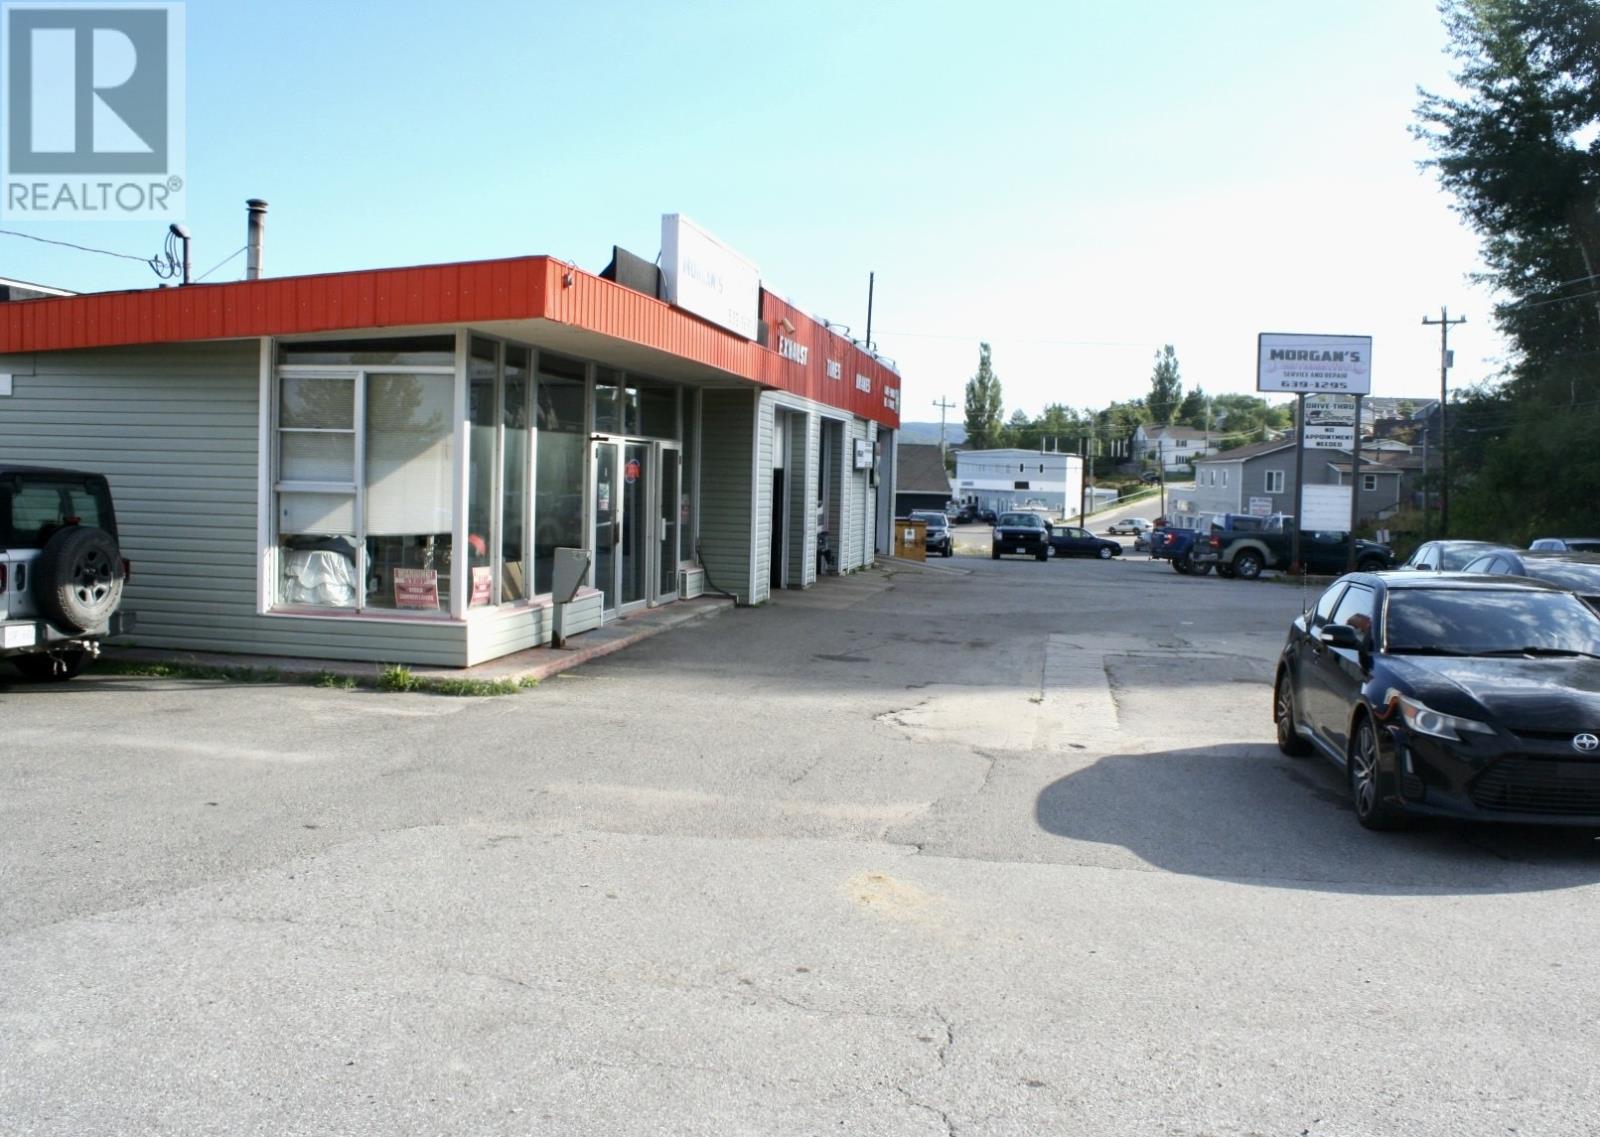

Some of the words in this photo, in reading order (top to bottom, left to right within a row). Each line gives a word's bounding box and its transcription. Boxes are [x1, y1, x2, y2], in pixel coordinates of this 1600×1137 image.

[1270, 349, 1361, 362] MORGAN'S
[1281, 380, 1348, 389] 639-1295
[1305, 402, 1355, 410] DRIVE-THRU
